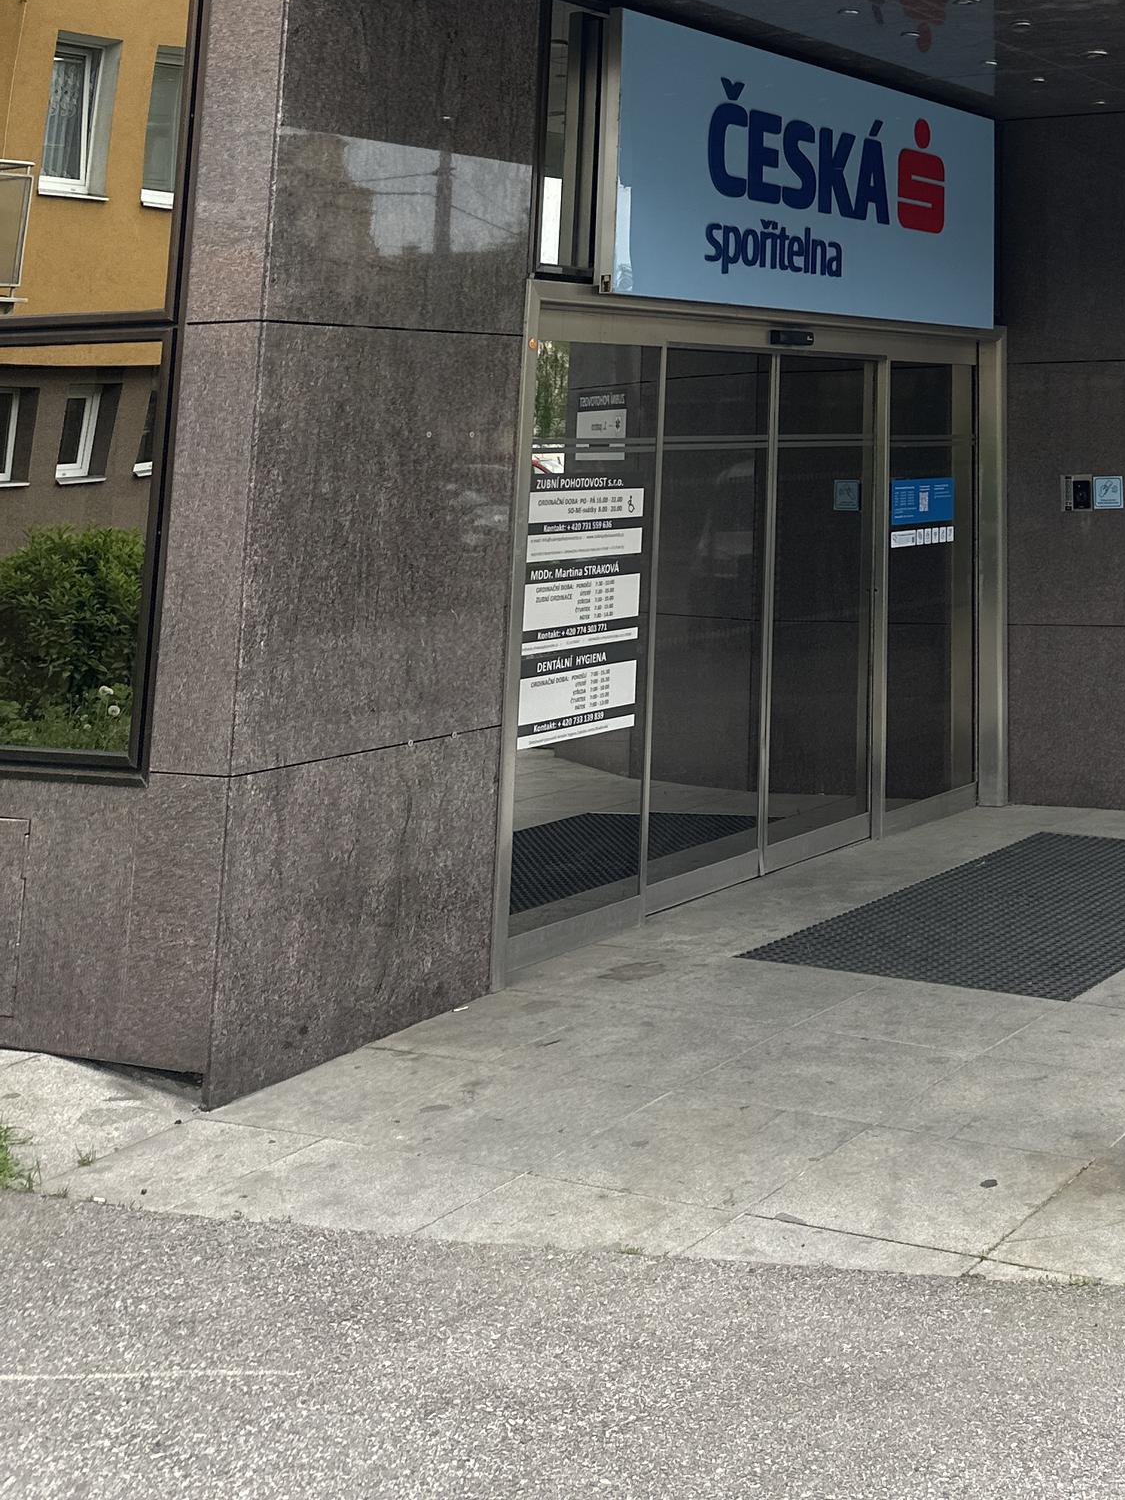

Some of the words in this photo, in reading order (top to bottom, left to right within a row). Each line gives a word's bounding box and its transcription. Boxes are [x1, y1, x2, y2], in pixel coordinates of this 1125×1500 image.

[707, 76, 890, 225] ČESKÁ
[704, 218, 843, 278] spořitelna
[536, 476, 559, 489] ZUBNÍ
[560, 477, 607, 489] POHOTOVOST
[608, 479, 624, 487] s.r.o.
[554, 567, 582, 579] Martina
[584, 561, 619, 576] STRAKOVÁ
[537, 630, 560, 640] Kontakt:
[566, 627, 576, 636] 420
[537, 655, 573, 673] DENTÁLNÍ
[576, 652, 607, 666] HYGIENA
[533, 723, 556, 732] Kontakt:
[562, 718, 572, 727] 420
